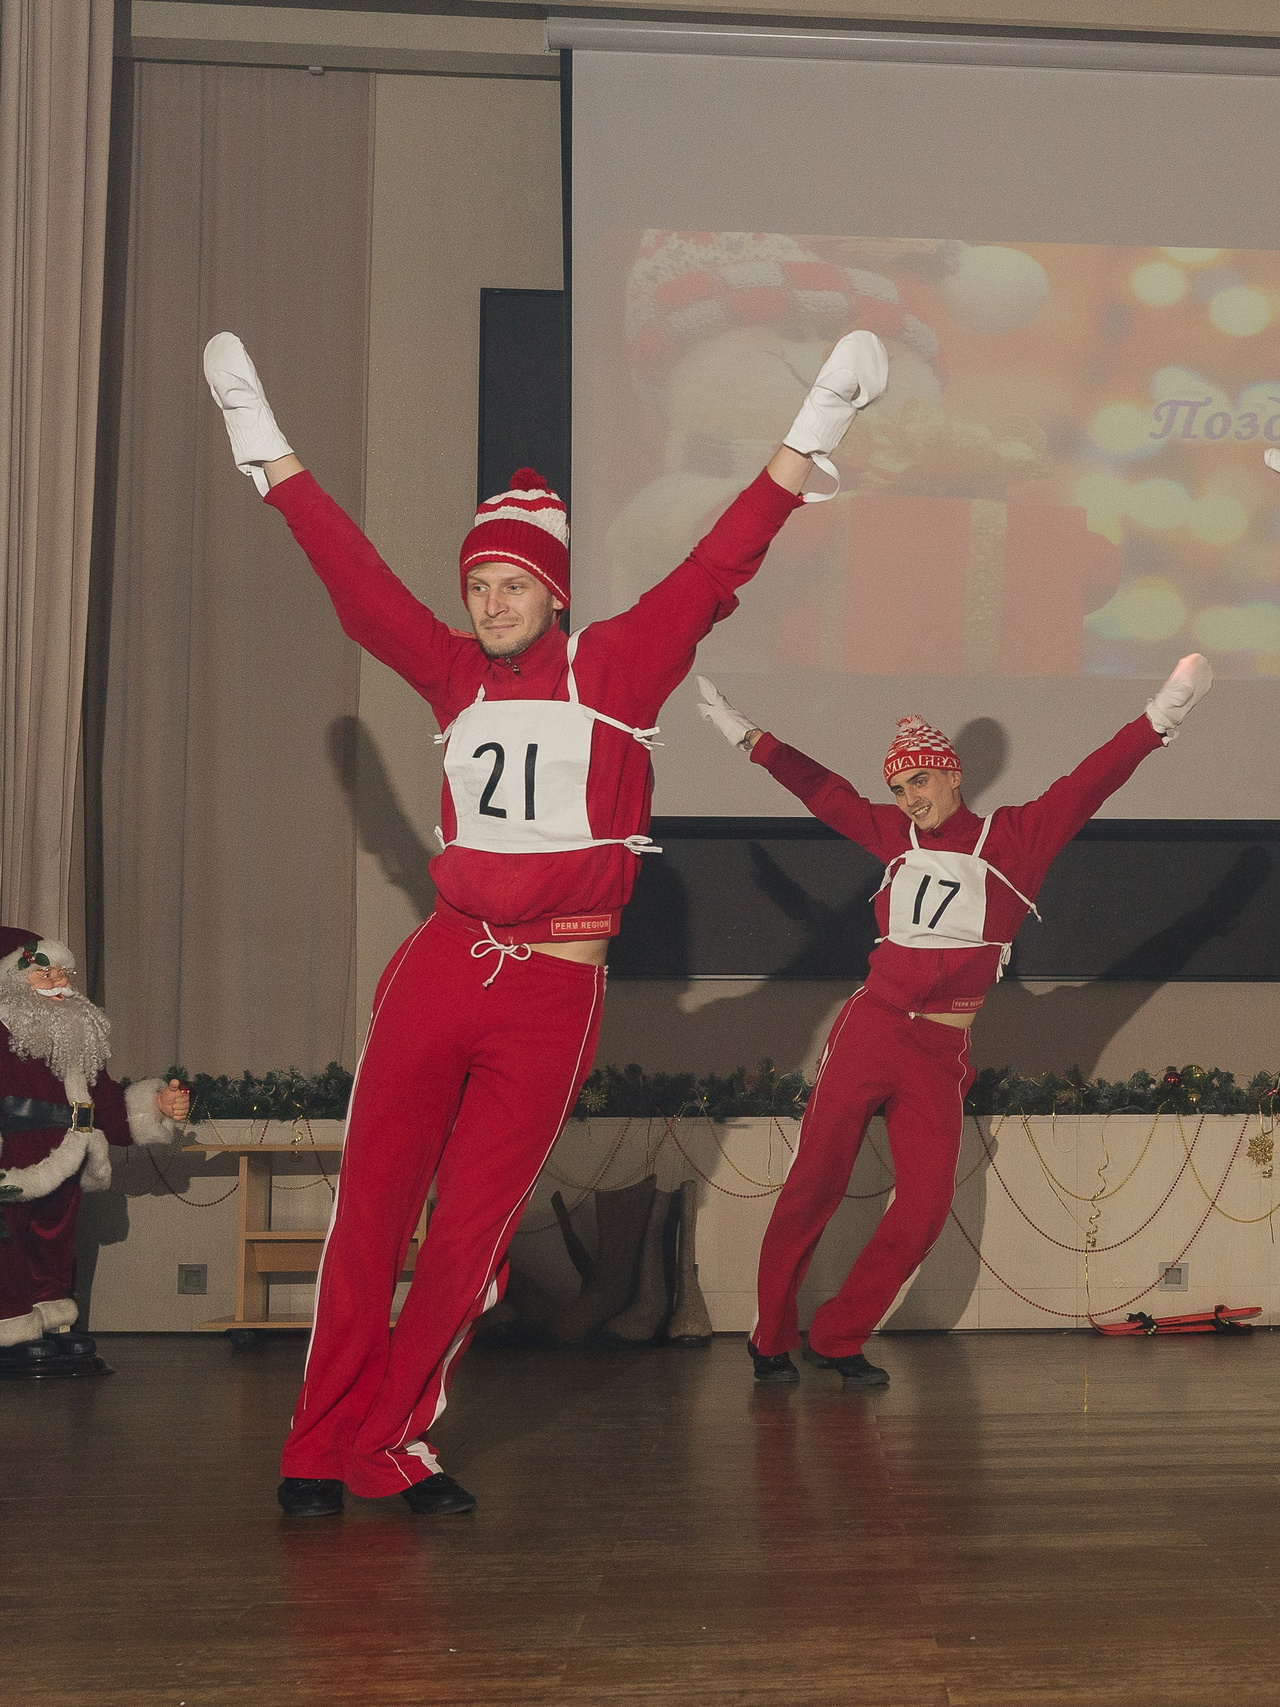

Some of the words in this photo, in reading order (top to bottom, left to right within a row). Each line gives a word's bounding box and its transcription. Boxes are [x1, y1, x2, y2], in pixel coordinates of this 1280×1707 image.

[471, 741, 539, 820] 21
[555, 922, 579, 930] PERM
[581, 920, 609, 930] REGION
[911, 873, 961, 930] 17
